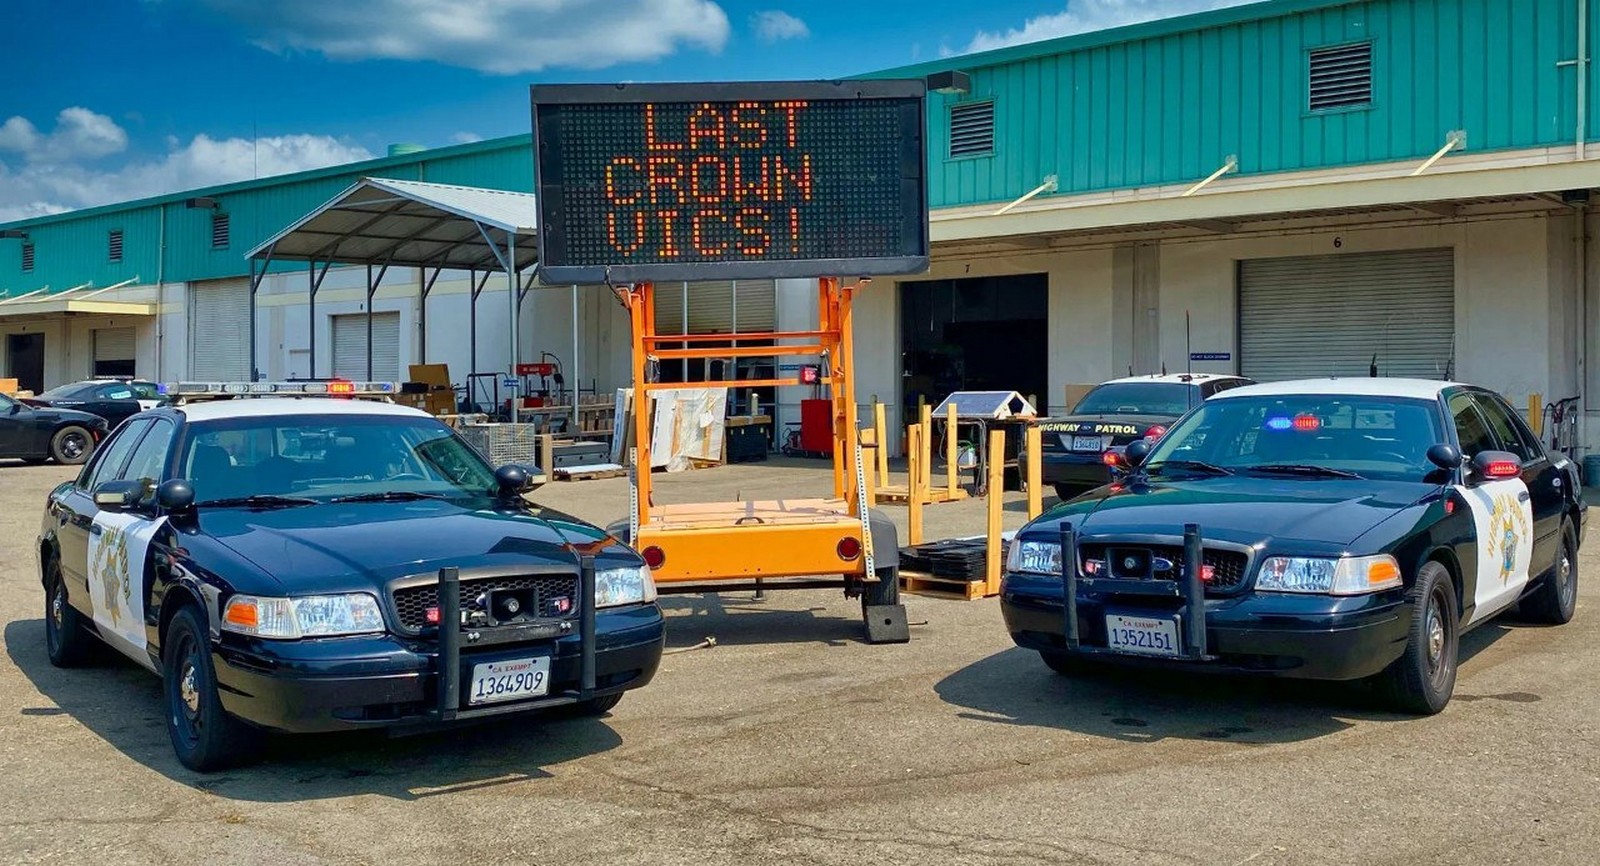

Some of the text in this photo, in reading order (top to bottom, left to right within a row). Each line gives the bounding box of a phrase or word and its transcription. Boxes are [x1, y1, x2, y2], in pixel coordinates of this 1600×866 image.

[646, 101, 808, 150] LAST
[606, 154, 811, 204] CROWN
[608, 207, 798, 257] VICS!
[1334, 236, 1342, 248] 6
[965, 263, 971, 274] 7
[1039, 423, 1081, 432] HIGHWAY
[1094, 424, 1138, 434] PATROL
[1112, 628, 1173, 650] 1352151
[505, 663, 532, 672] EXEMPT
[475, 671, 544, 697] 1364909
